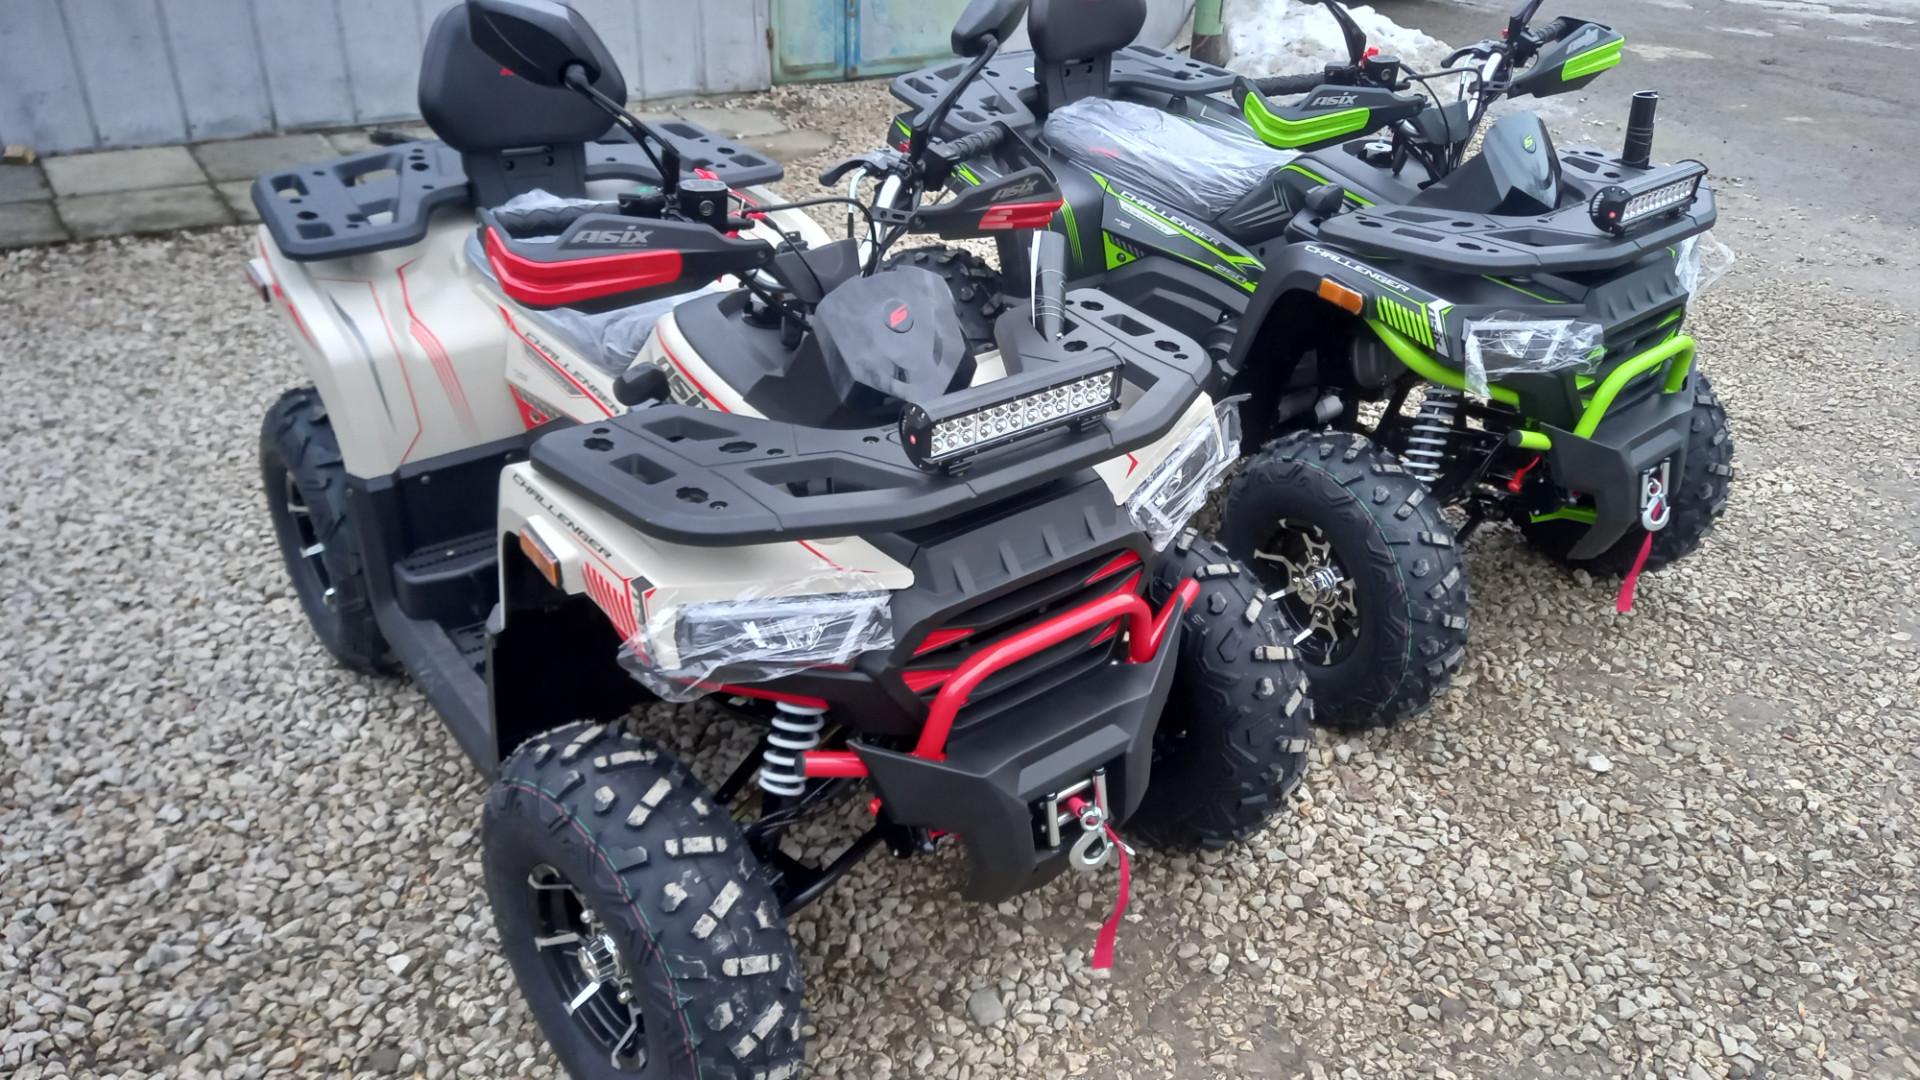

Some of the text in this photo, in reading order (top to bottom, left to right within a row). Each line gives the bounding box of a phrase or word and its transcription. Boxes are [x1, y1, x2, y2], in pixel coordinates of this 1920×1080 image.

[1120, 190, 1222, 246] CHALLENGER
[1304, 244, 1411, 292] CHALLENGER
[524, 332, 621, 415] CHALLENGER
[512, 473, 612, 559] CHALLENGER
